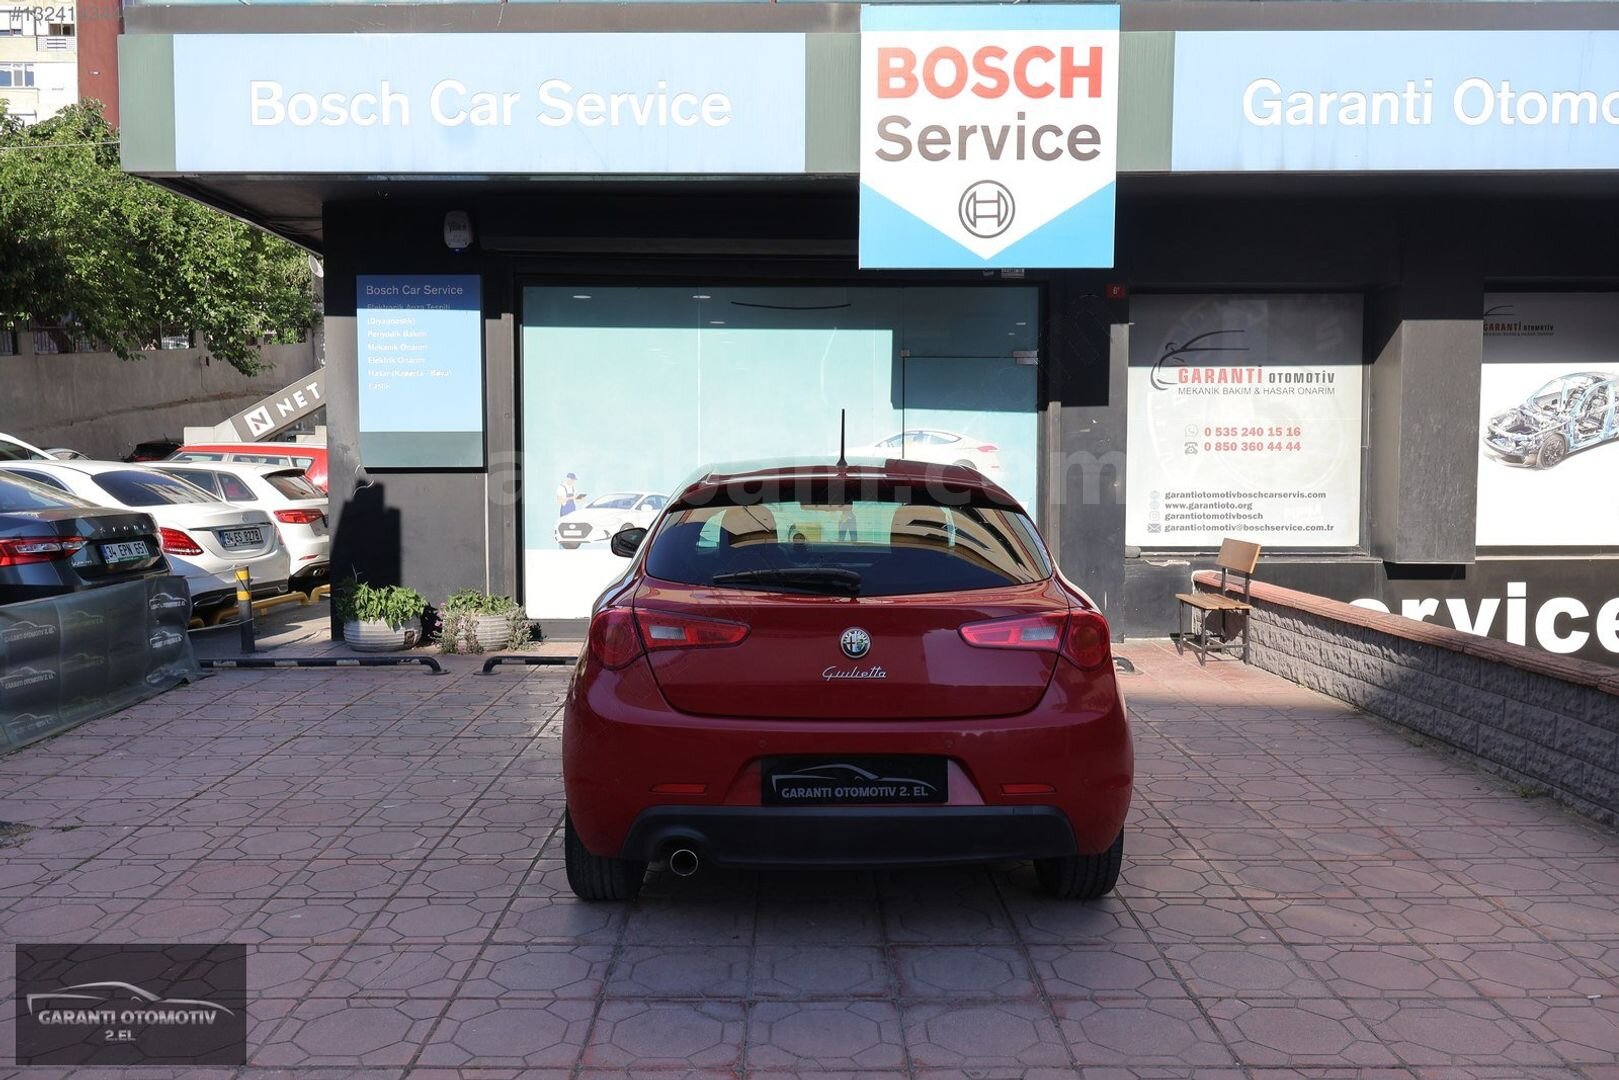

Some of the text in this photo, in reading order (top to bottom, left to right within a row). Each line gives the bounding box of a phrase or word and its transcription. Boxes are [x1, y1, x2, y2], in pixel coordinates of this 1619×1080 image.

[877, 45, 1102, 99] BOSCH
[249, 78, 732, 127] Bosch Car Service
[1242, 77, 1619, 126] Garanti Otomo
[875, 111, 1101, 162] Service
[366, 284, 463, 295] Bosch Car Service
[1223, 387, 1252, 395] BAKIM
[1254, 387, 1260, 395] &
[1263, 387, 1295, 395] HASAR
[1298, 387, 1336, 395] ONARIM
[276, 382, 321, 418] NET
[1204, 427, 1301, 437] 0 535 240 15 16
[1204, 442, 1301, 451] 0 850 360 44 44
[1164, 490, 1327, 500] garantiotomotivboschcarservis.com
[1164, 501, 1253, 511] www.garantioto.org
[1164, 512, 1264, 521] garantiotomotivbosch
[1164, 523, 1335, 532] garantiotomotiv@boschservice.com.tr
[225, 533, 234, 544] 34
[106, 546, 116, 558] 34
[822, 665, 887, 681] Giulietta
[781, 788, 832, 798] GARANTI
[835, 786, 897, 798] OTOMOTIV
[899, 786, 911, 796] 2.
